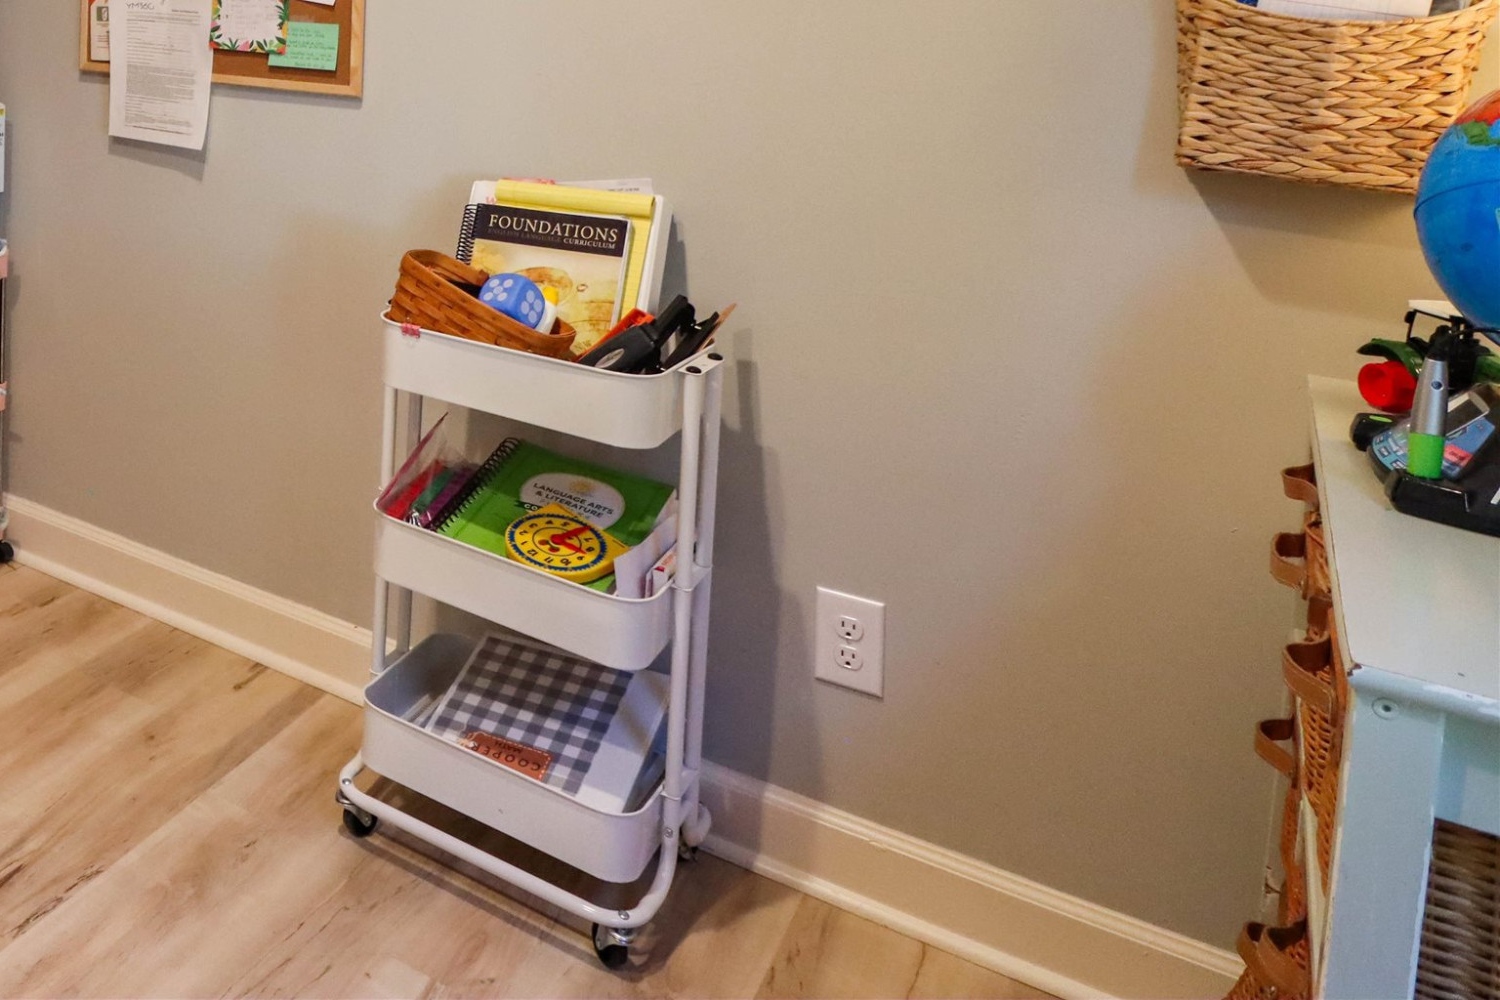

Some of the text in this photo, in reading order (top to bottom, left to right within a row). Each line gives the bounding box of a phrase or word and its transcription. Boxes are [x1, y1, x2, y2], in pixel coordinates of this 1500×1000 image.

[488, 214, 618, 243] FOUNDATIONS
[563, 237, 616, 250] CURRICULUM
[533, 482, 614, 515] LANGUAGE ARTS
[545, 493, 604, 518] LITERATURE
[470, 745, 541, 771] COOPER
